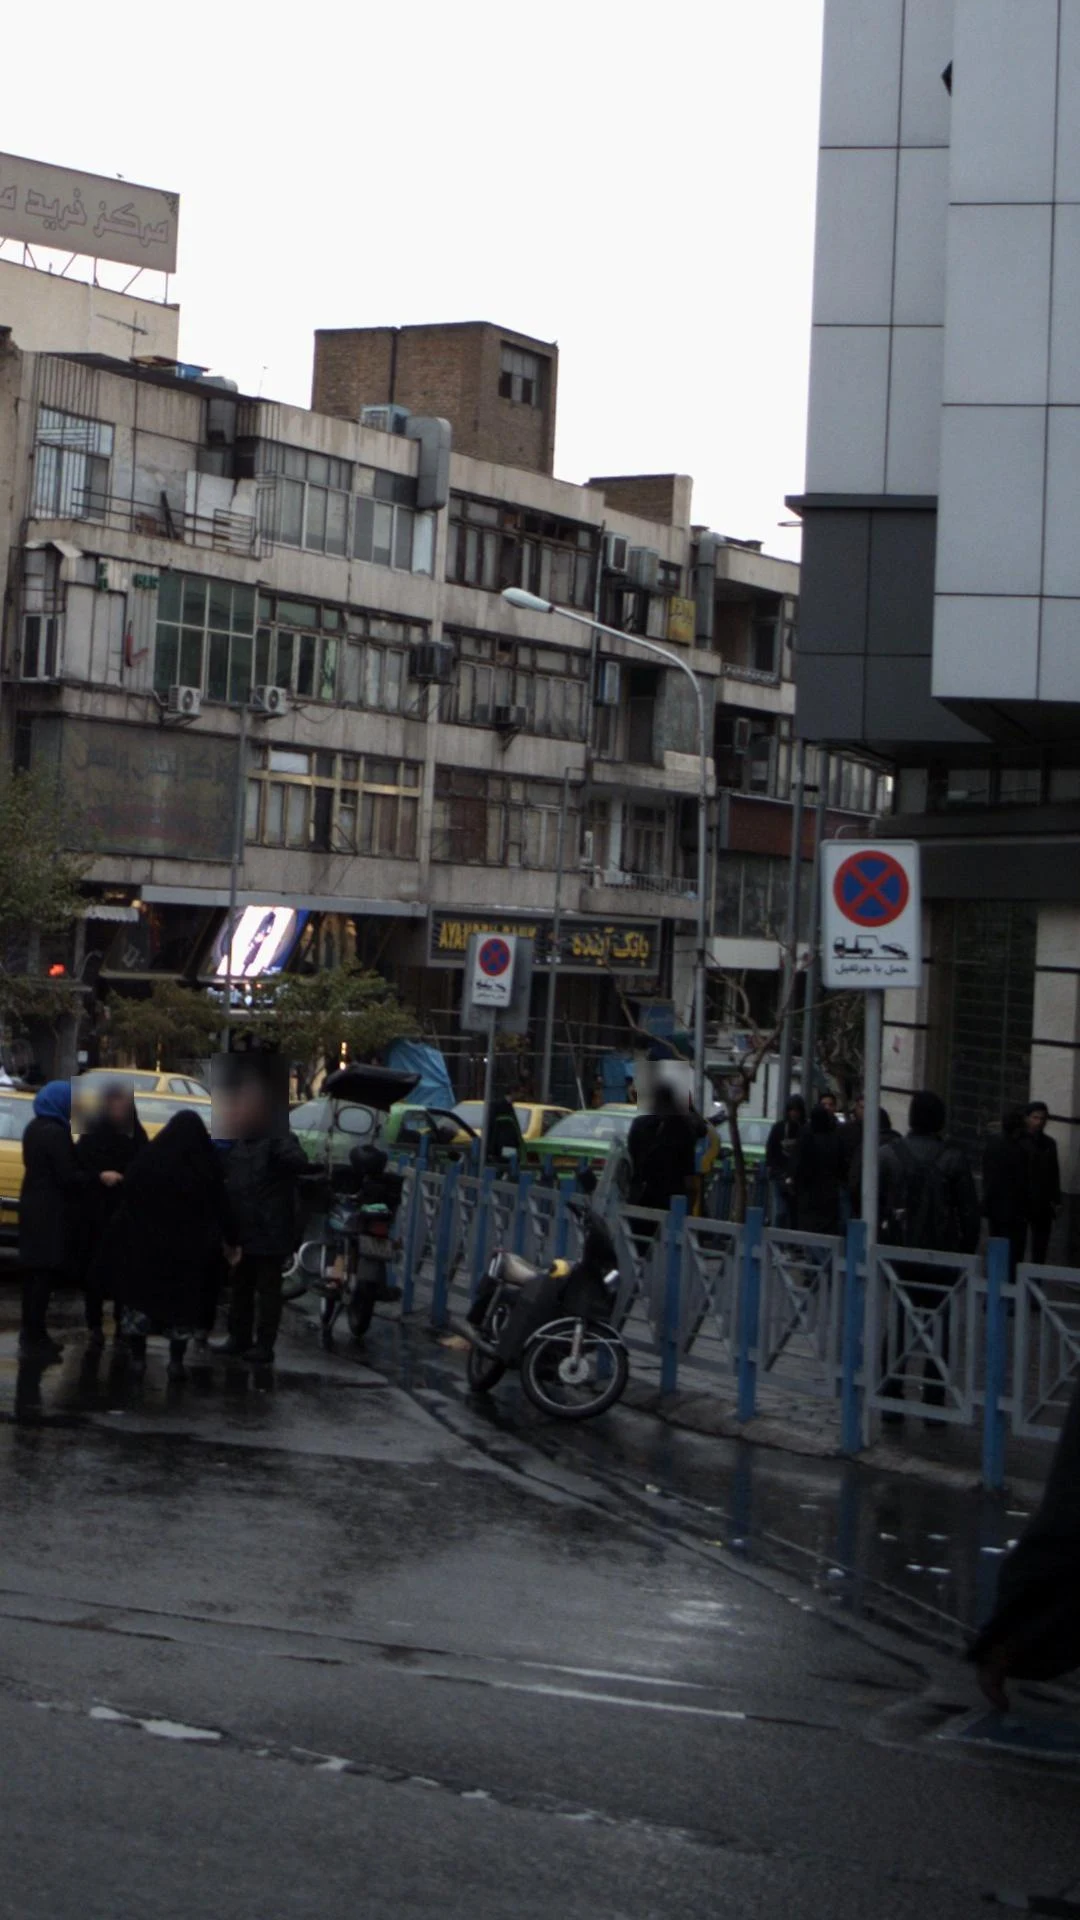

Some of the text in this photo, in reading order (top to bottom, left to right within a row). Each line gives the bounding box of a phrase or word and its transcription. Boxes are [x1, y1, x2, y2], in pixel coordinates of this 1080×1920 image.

[25, 187, 87, 231] خرید
[93, 200, 169, 248] مرکز
[613, 931, 649, 968] بانک
[873, 964, 883, 974] با
[885, 964, 908, 976] حمل
